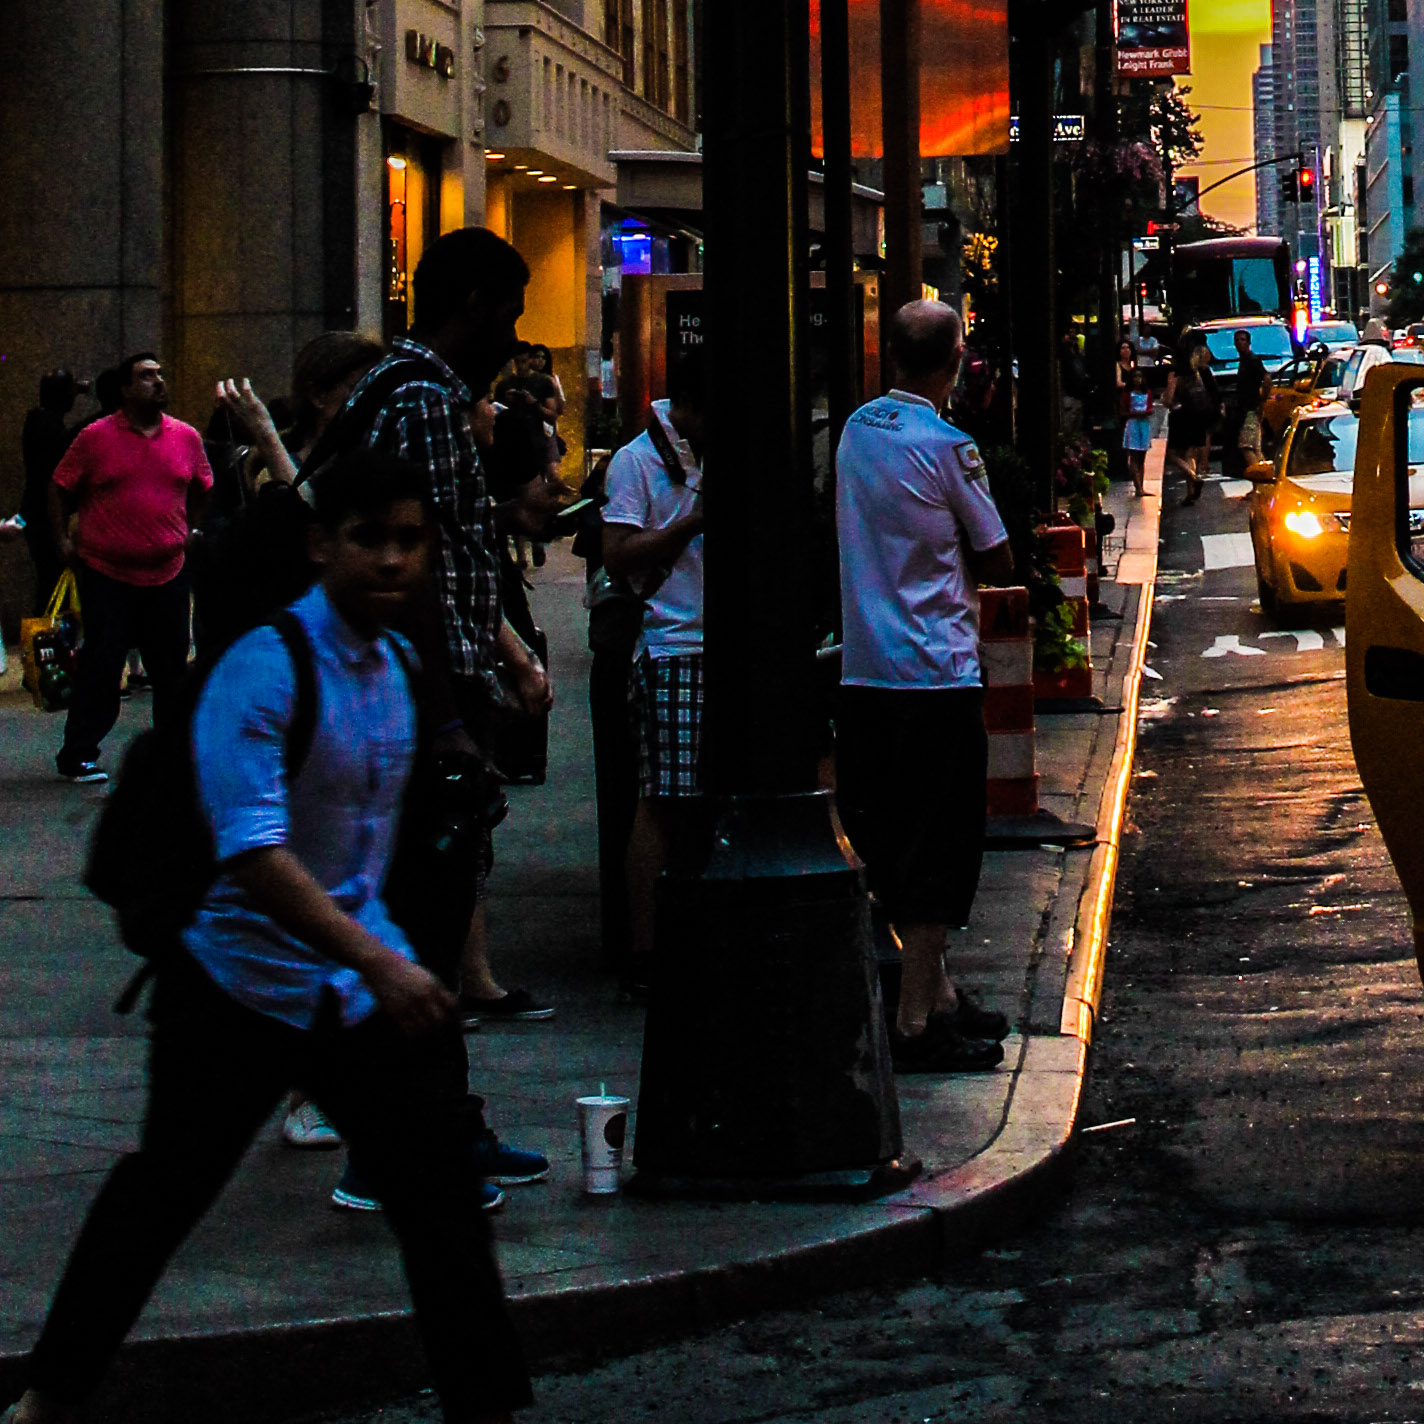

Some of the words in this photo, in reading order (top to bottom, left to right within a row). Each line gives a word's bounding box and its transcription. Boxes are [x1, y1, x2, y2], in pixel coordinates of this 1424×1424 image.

[1140, 6, 1174, 14] LEADER
[1132, 15, 1155, 23] REAL
[1149, 59, 1175, 70] Frank
[1055, 121, 1081, 136] Ave
